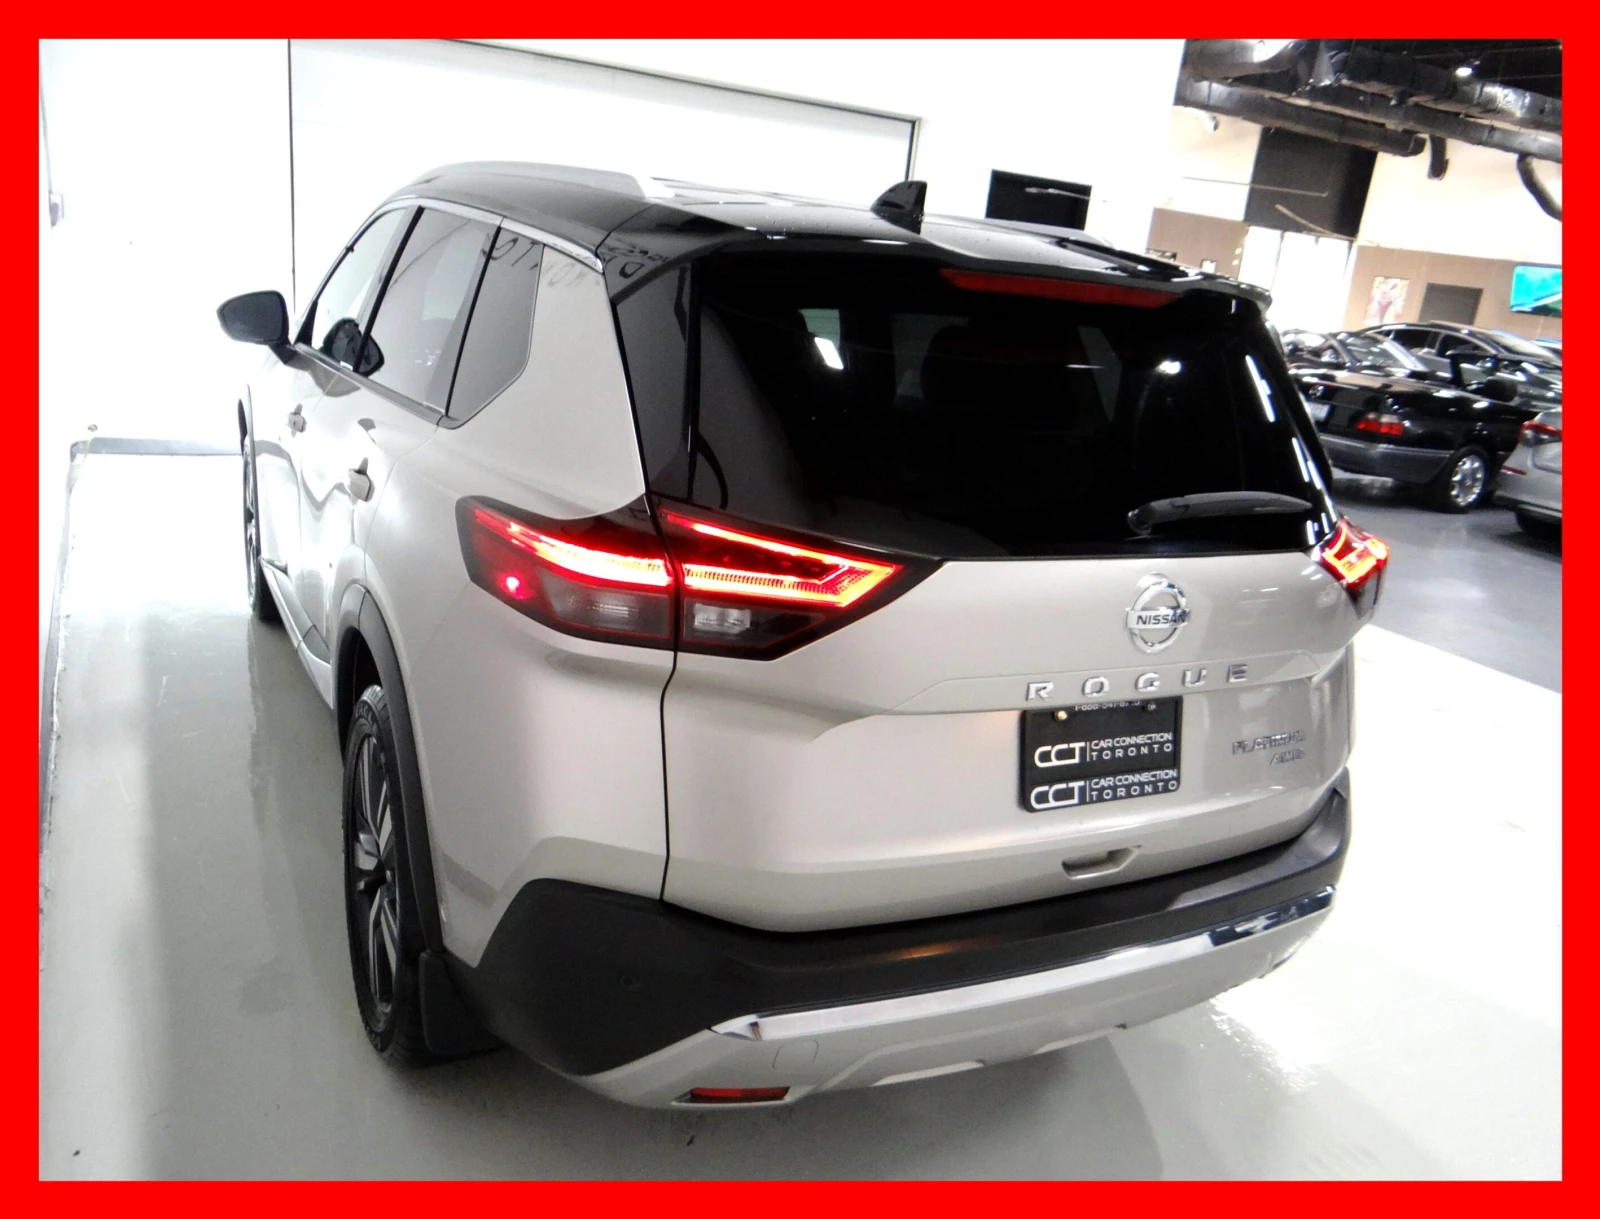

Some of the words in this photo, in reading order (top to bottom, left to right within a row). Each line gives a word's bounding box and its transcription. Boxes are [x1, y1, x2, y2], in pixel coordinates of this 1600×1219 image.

[1136, 608, 1190, 625] NISSAN
[1026, 663, 1249, 701] ROGUE
[1091, 738, 1113, 750] CAR
[1115, 732, 1173, 747] CONNECTION
[1034, 742, 1086, 768] CCT
[1091, 743, 1173, 761] TORONTO
[1269, 748, 1305, 766] AWD
[1091, 778, 1113, 789] CAR
[1115, 769, 1178, 786] CONNECTION
[1030, 781, 1085, 809] CCT
[1091, 781, 1178, 801] TORONTO
